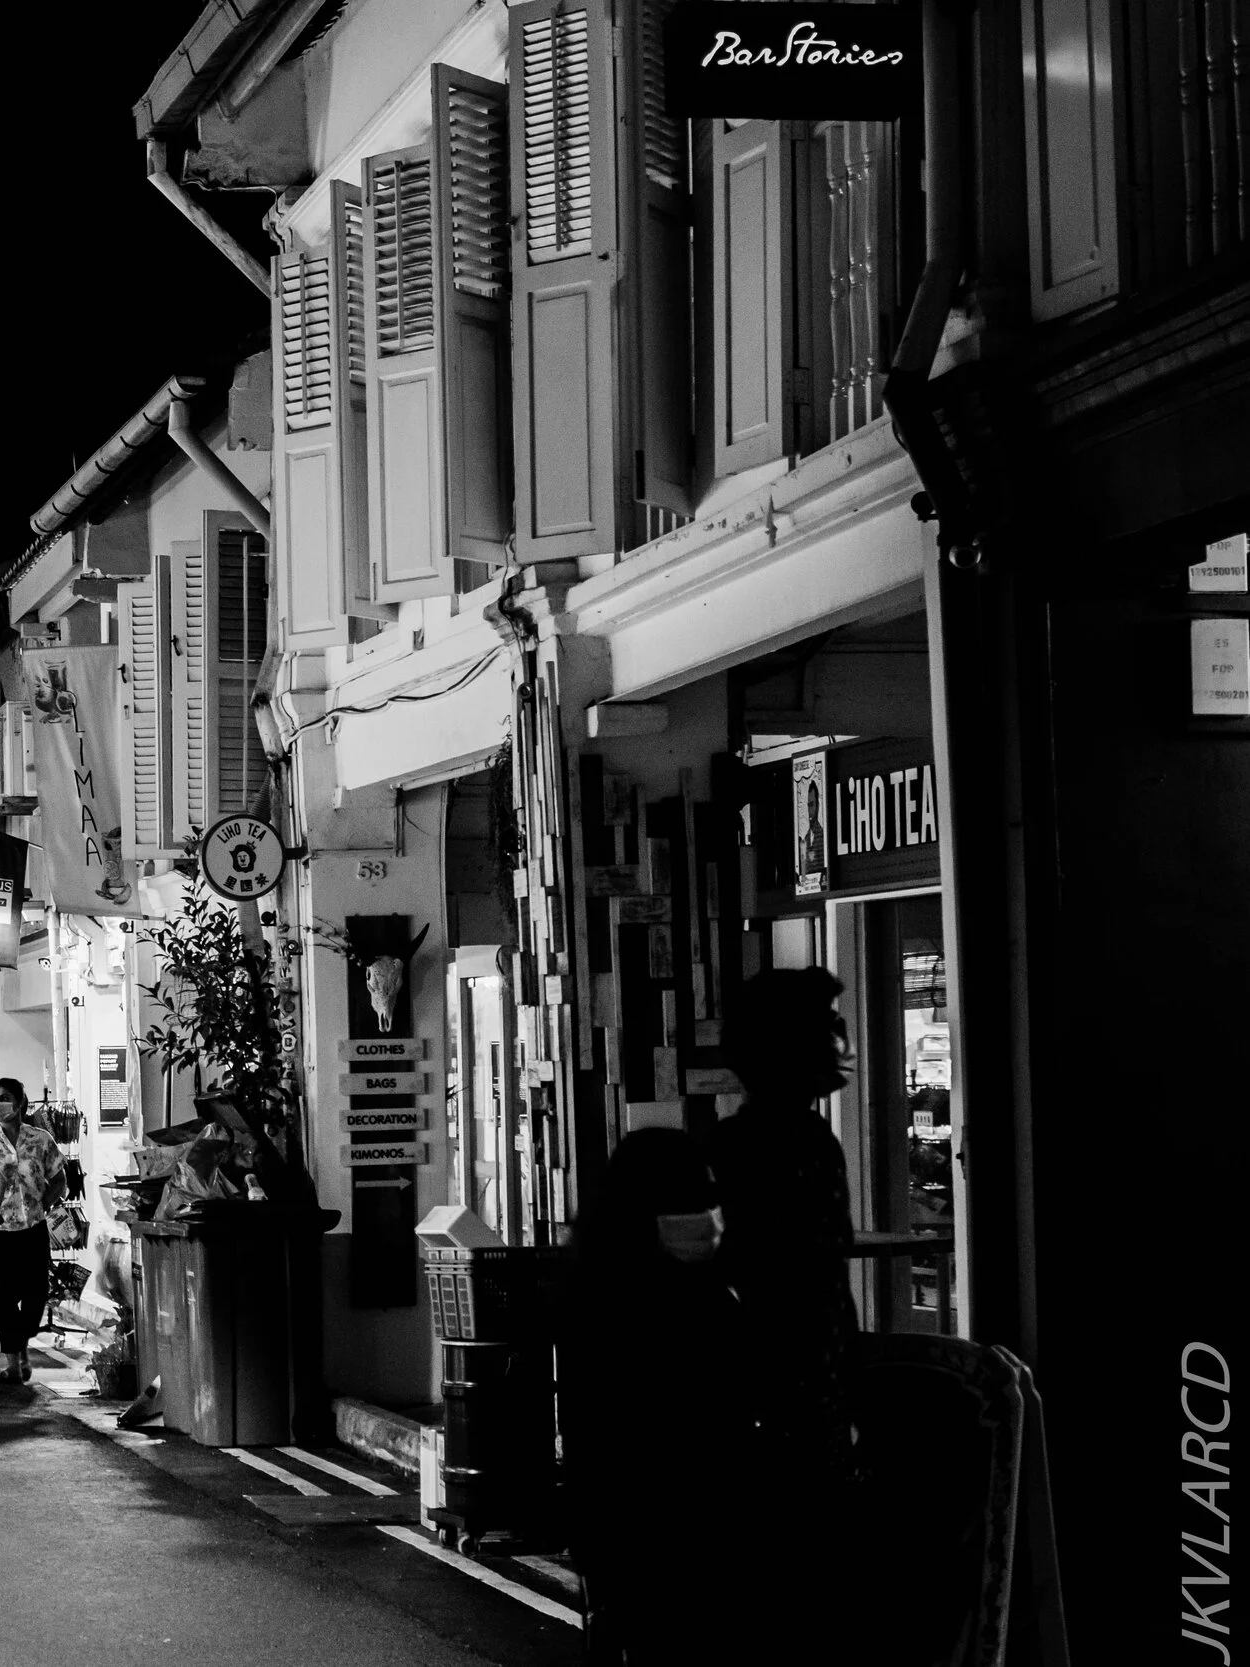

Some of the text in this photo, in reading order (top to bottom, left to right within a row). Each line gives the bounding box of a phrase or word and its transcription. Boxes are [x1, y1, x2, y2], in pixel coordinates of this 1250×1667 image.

[890, 765, 937, 848] TEA
[248, 823, 267, 842] TEA
[356, 1044, 406, 1056] CLOTHES
[366, 1078, 397, 1089] BAGS
[347, 1114, 417, 1126] DECORATION
